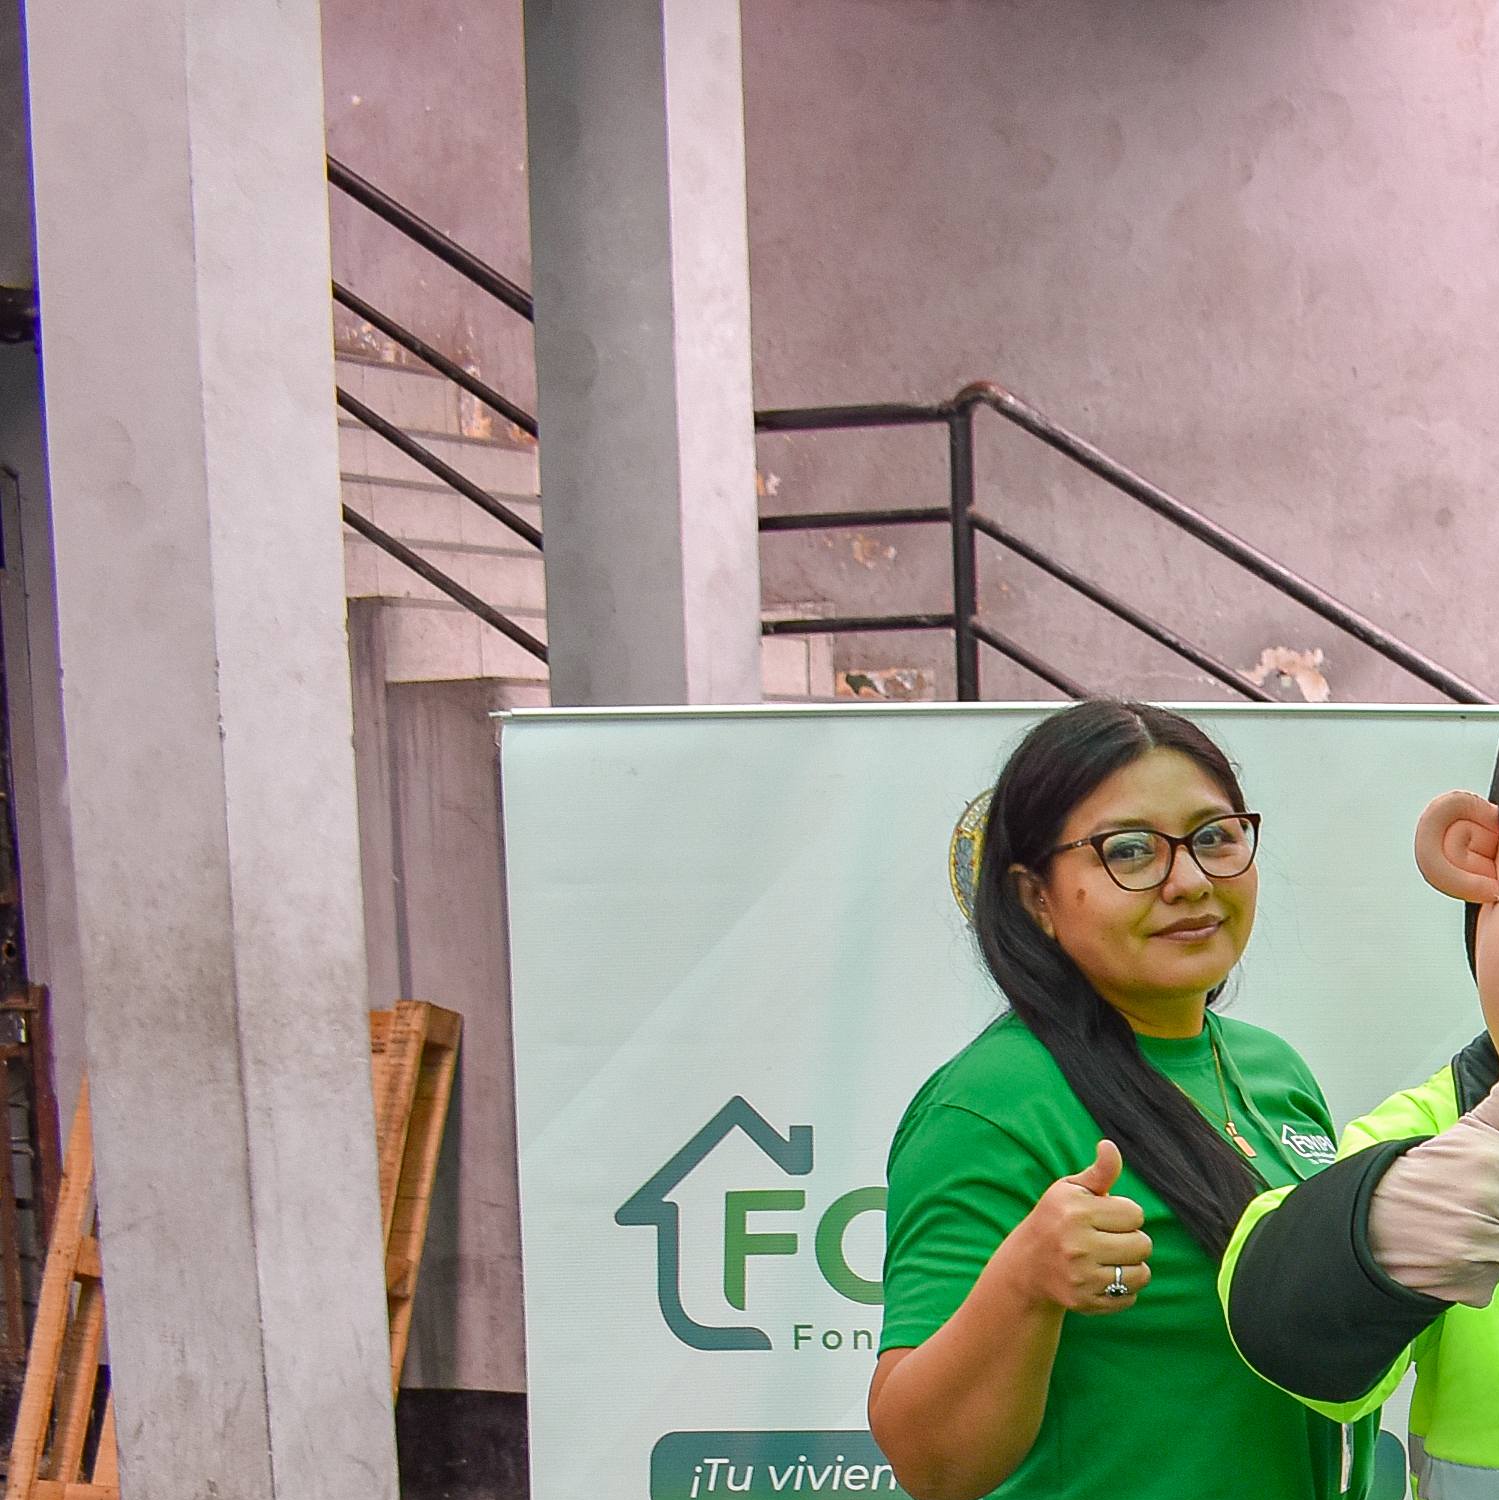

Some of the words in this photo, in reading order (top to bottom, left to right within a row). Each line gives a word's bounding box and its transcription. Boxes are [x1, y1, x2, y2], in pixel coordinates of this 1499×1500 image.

[794, 1323, 876, 1350] Fon
[690, 1456, 757, 1497] ¡Tu
[767, 1456, 900, 1491] vivien
